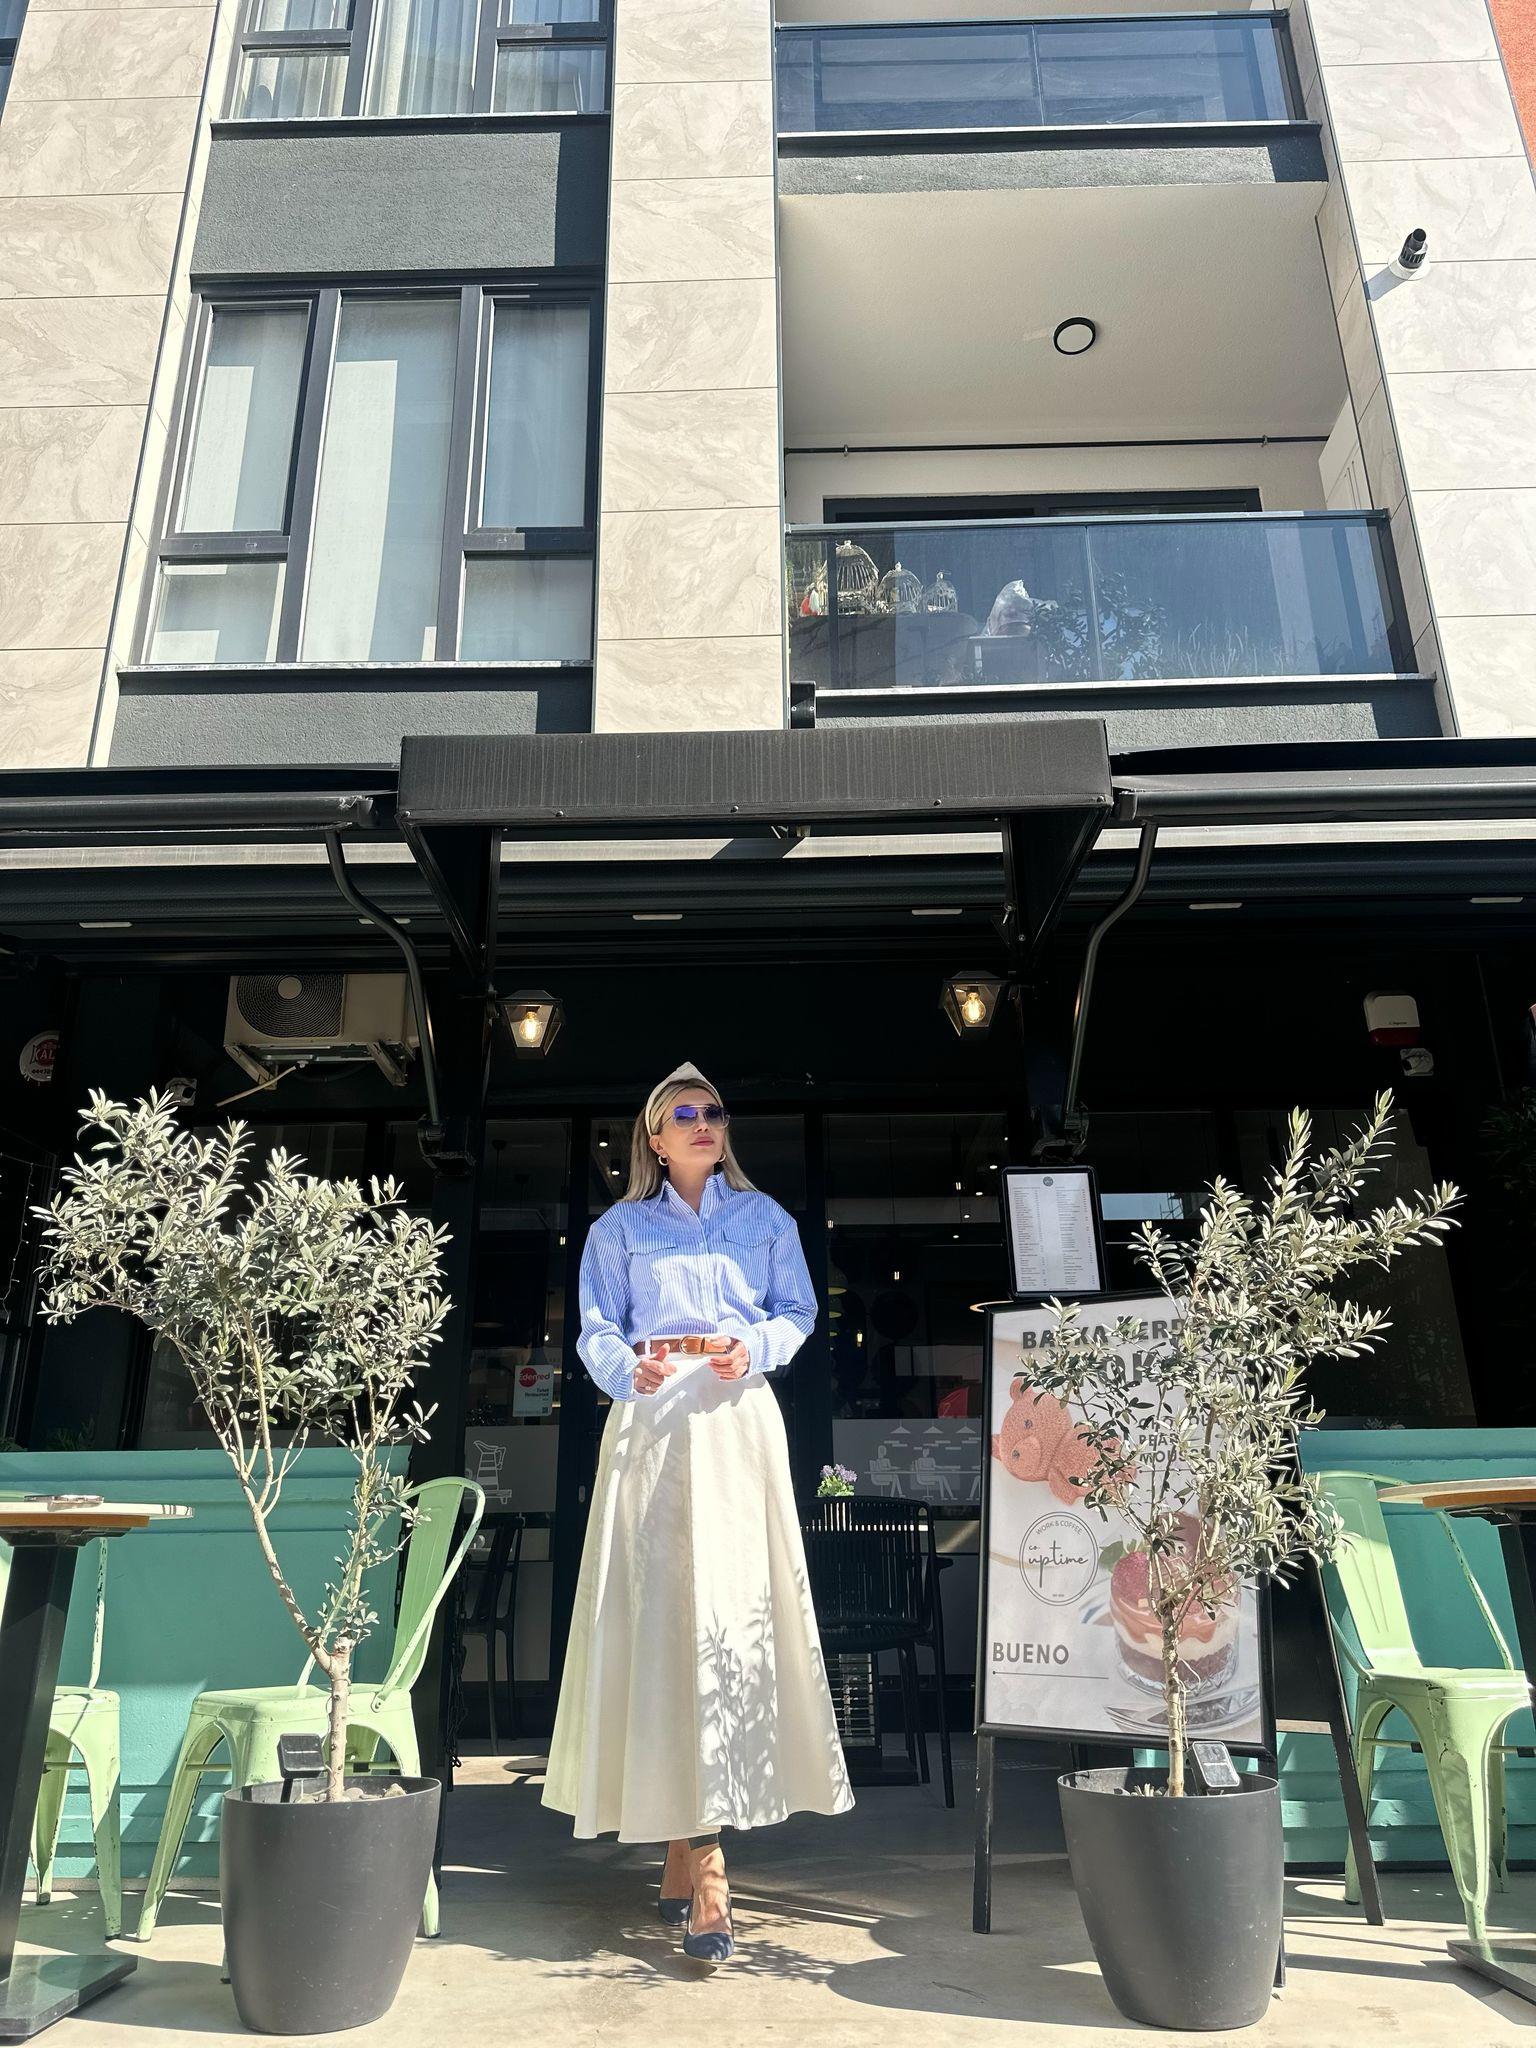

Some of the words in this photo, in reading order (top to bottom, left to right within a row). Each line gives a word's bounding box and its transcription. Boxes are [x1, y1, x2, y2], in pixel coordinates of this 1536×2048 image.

[30, 1044, 56, 1064] KAL
[1022, 1325, 1109, 1349] BAKA
[1035, 1520, 1054, 1535] WORK
[1060, 1520, 1083, 1536] COFFEE
[1028, 1540, 1088, 1588] uptime
[992, 1642, 1069, 1665] BUENO
